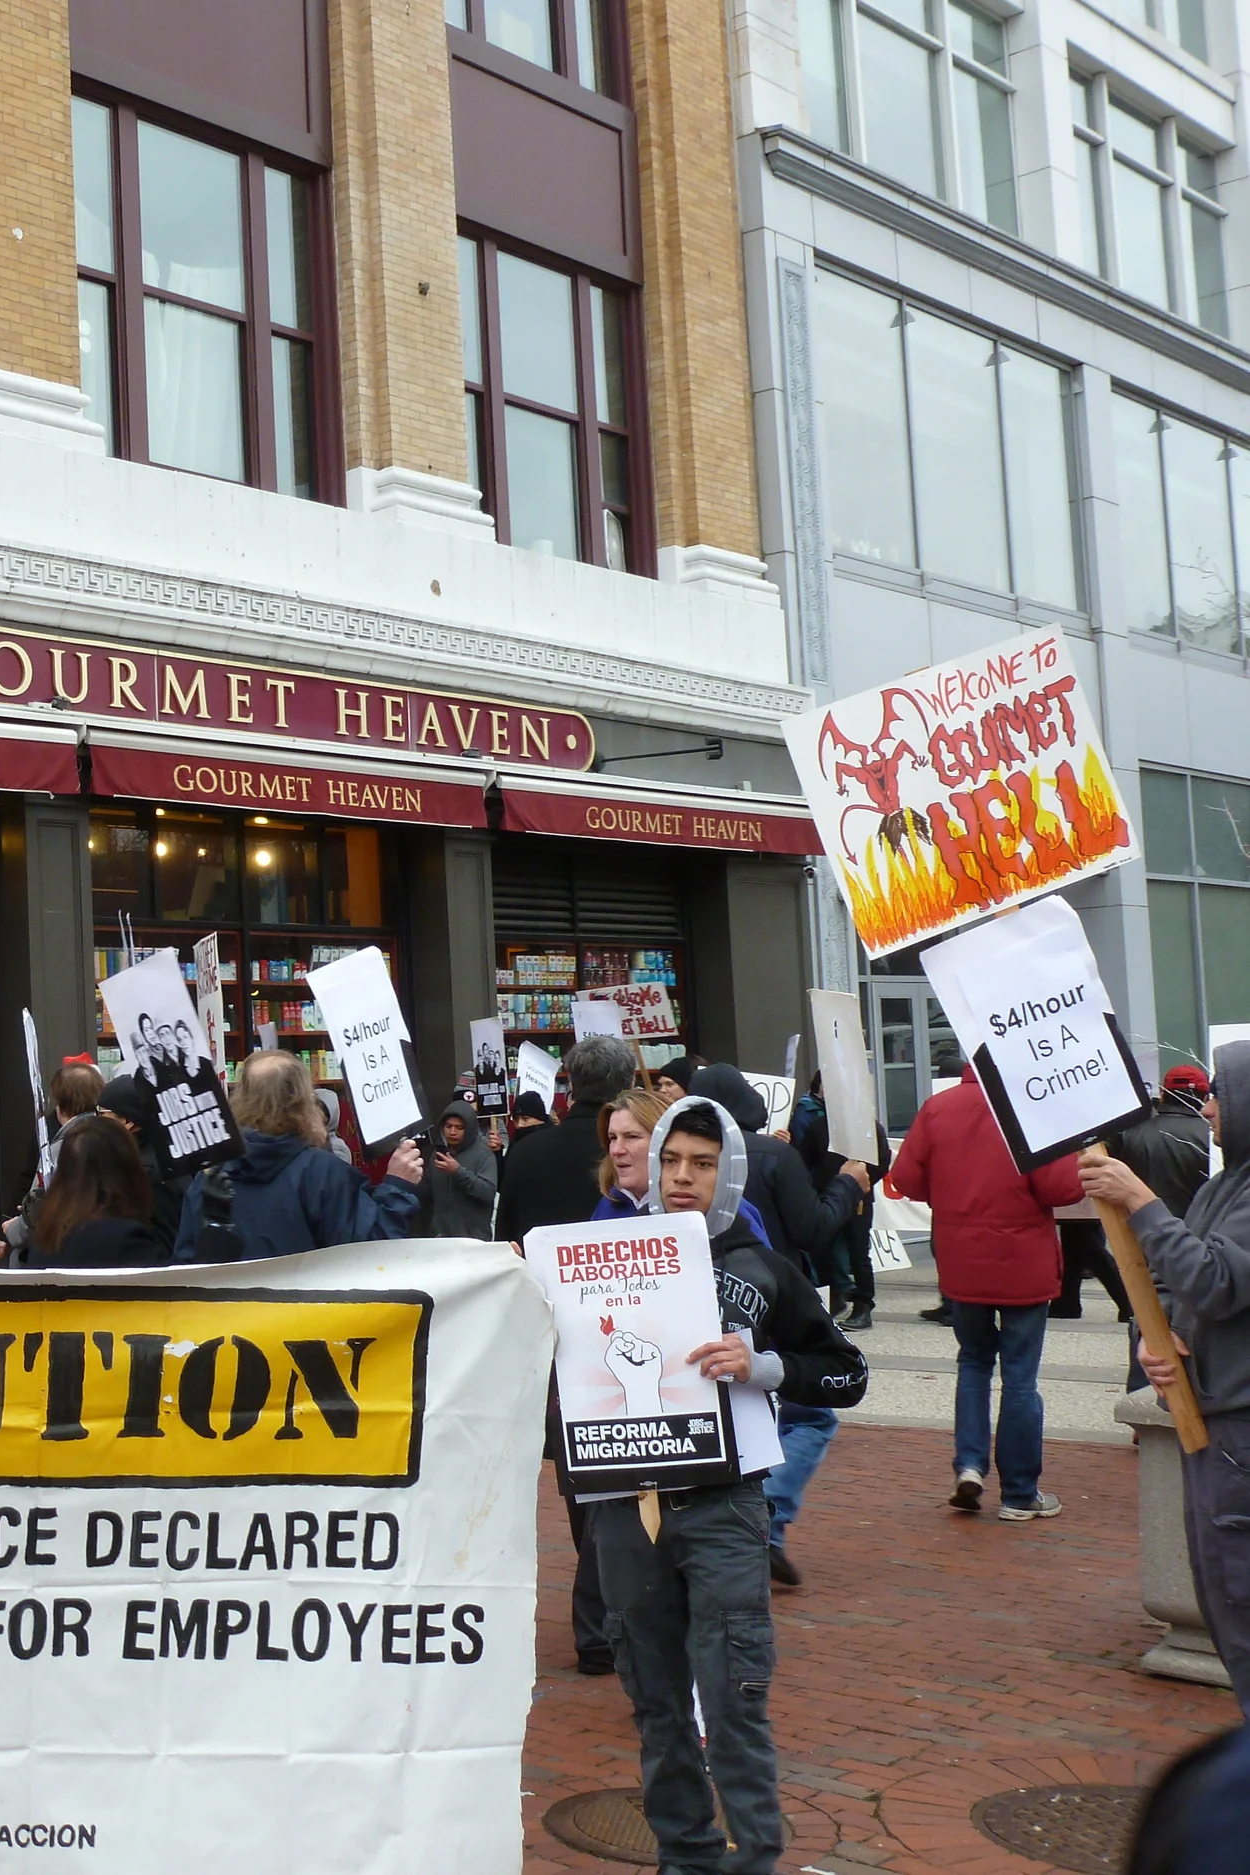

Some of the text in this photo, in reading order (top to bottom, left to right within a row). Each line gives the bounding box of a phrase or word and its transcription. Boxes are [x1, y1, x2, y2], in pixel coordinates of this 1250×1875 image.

[336, 688, 553, 761] HEAVEN
[172, 764, 423, 813] GOURMET HEAVEN
[585, 805, 763, 843] GOURMET HEAVEN
[926, 760, 1131, 912] HELL
[989, 984, 1084, 1038] $4/hour
[343, 1016, 391, 1047] $4/hour
[1027, 1024, 1080, 1061] Is A
[362, 1045, 391, 1071] Is A
[1025, 1049, 1109, 1101] Crime!
[361, 1071, 403, 1103] Crime!
[557, 1236, 679, 1267] DERECHOS
[559, 1259, 681, 1284] LABORALES
[580, 1275, 661, 1304] para Todos
[605, 1294, 641, 1307] en la
[574, 1421, 672, 1442] REFORMA
[576, 1437, 697, 1460] MIGRATORIA
[84, 1509, 401, 1573] DECLARED
[121, 1597, 485, 1666] EMPLOYEES
